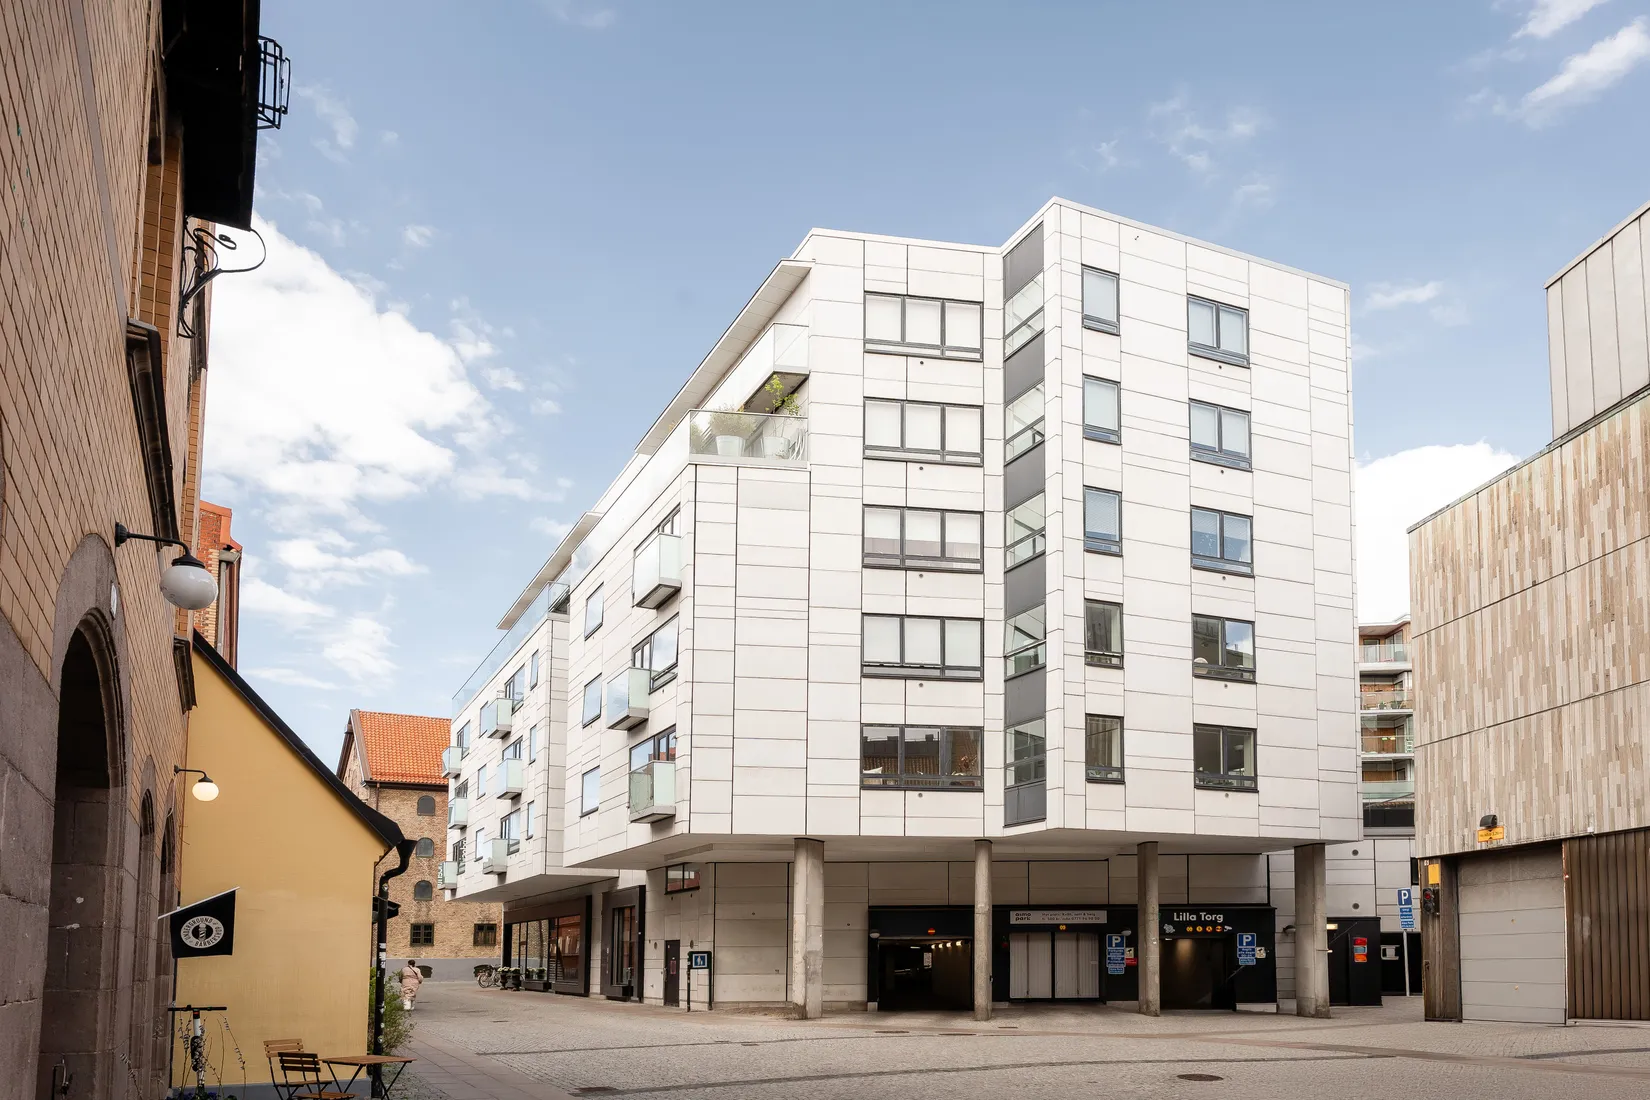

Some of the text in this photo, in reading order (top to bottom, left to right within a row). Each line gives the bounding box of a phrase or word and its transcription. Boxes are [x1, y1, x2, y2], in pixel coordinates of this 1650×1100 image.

[1401, 890, 1409, 905] P
[1173, 912, 1224, 923] Lilla Torg
[183, 917, 213, 941] UNDERGROUND
[1111, 935, 1121, 948] P
[1243, 934, 1252, 946] P
